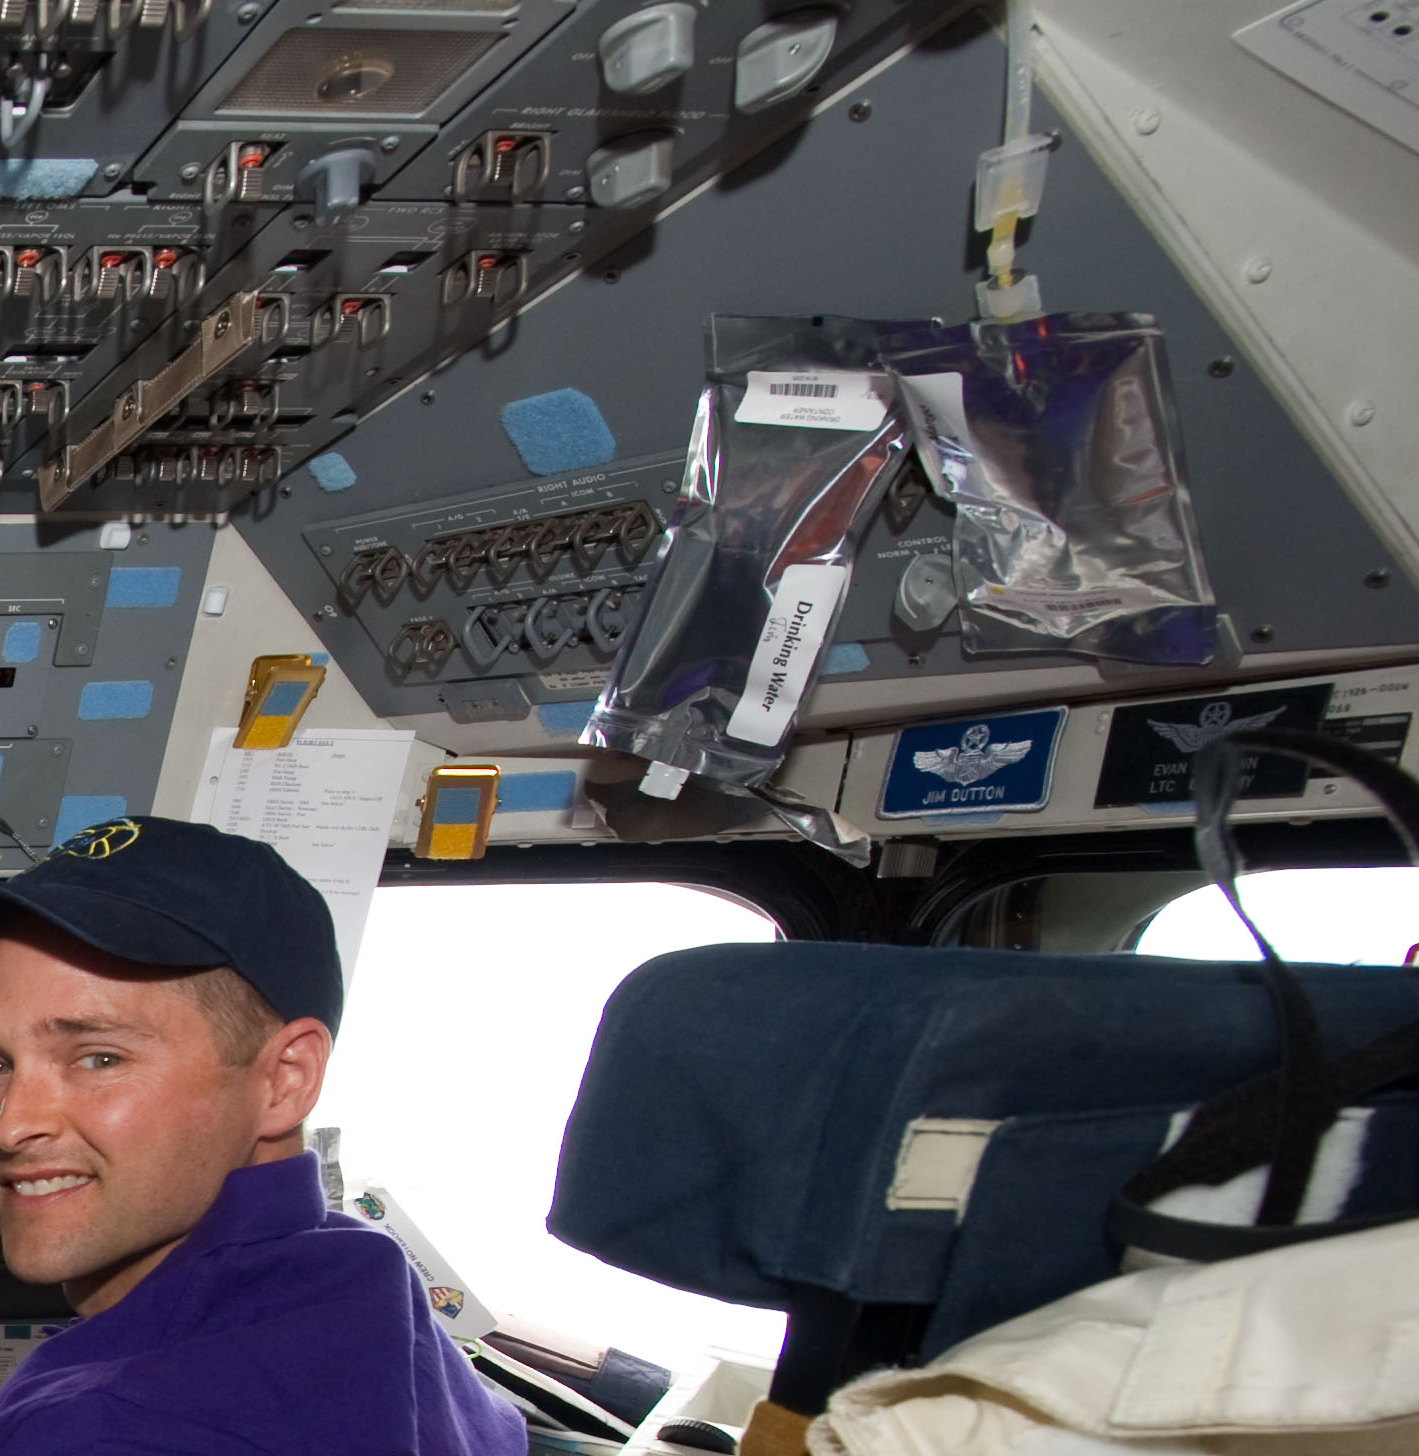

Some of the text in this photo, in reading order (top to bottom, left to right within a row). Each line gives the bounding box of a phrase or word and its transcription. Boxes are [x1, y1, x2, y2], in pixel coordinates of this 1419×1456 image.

[536, 472, 606, 494] RIGHT AUDIO
[897, 535, 949, 549] CONTROL
[877, 547, 911, 560] NORM
[761, 600, 814, 713] Drinking Water
[1153, 760, 1188, 777] EVAN
[922, 784, 1006, 804] JIM DUTTON
[1148, 778, 1177, 794] LTC
[415, 1259, 435, 1282] CREW
